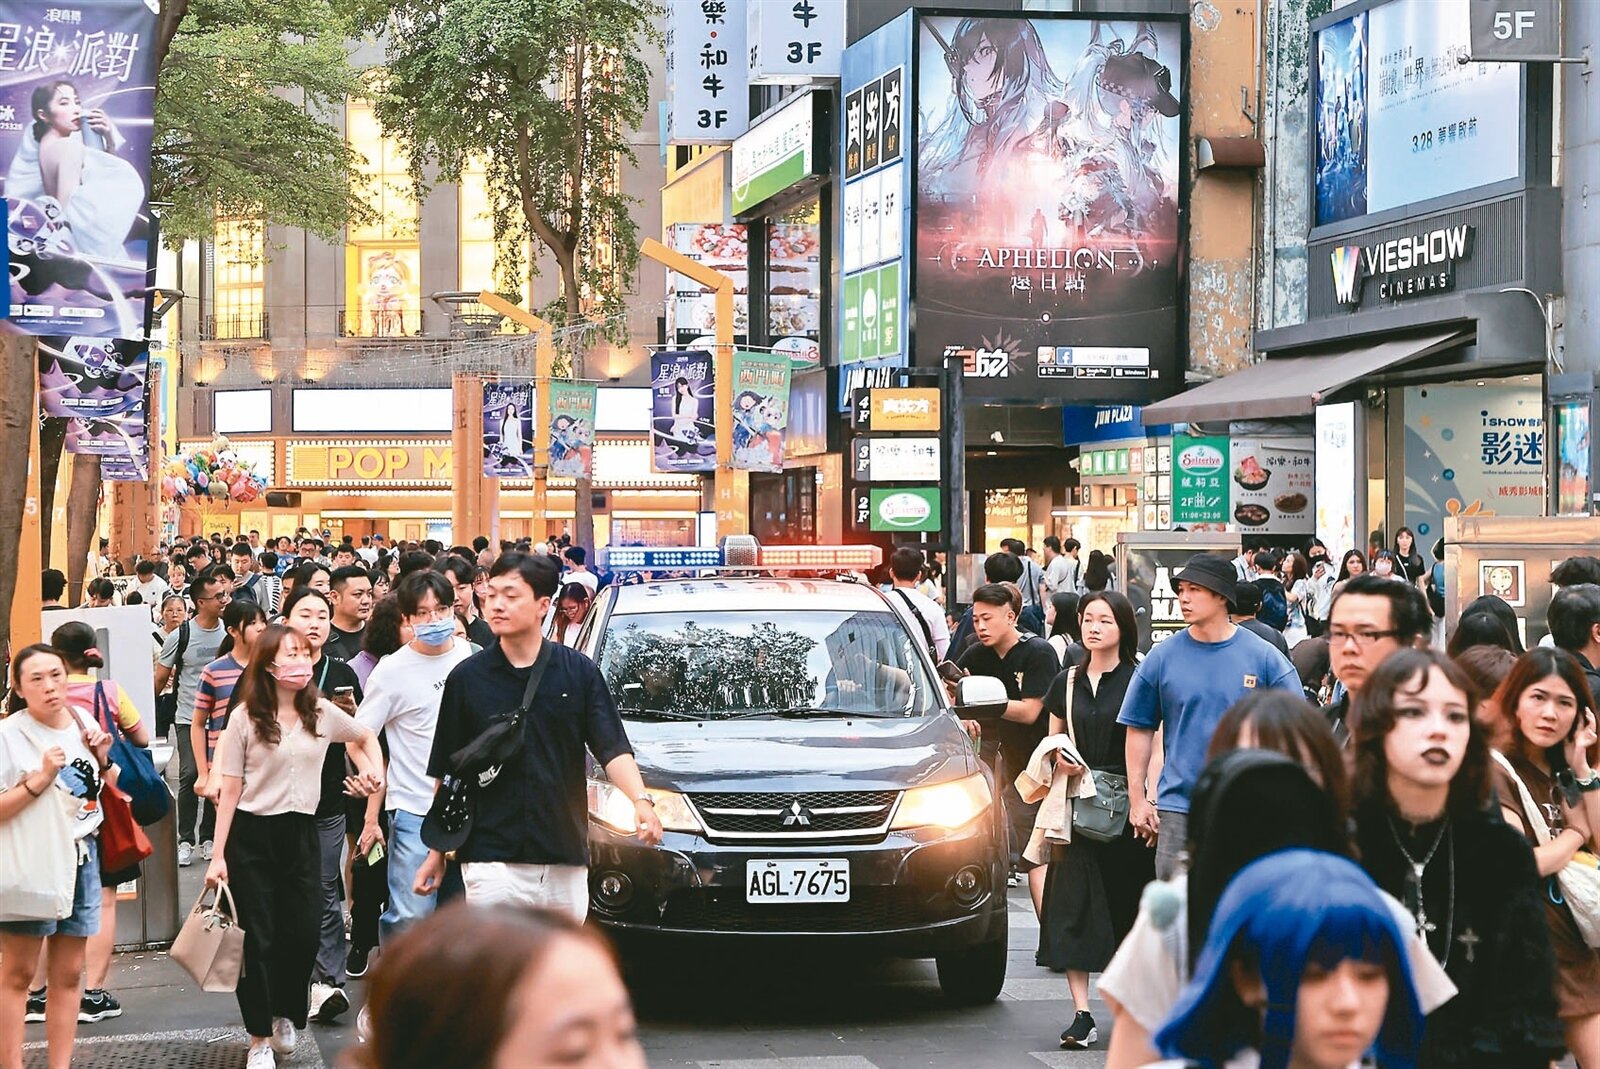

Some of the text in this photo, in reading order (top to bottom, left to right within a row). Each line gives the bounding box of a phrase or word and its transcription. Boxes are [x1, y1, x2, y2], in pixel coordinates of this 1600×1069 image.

[1493, 11, 1536, 40] 5F
[786, 41, 823, 64] 3F
[697, 109, 728, 129] 3F
[1412, 130, 1433, 154] 3.28
[977, 247, 1116, 274] APHELION
[1365, 224, 1468, 276] VIESHOW
[1380, 272, 1447, 299] CINEMAS
[658, 362, 708, 381] 星浪派對
[1111, 405, 1133, 423] PLAZA
[330, 448, 408, 479] POP
[1181, 497, 1193, 507] 2F
[720, 511, 733, 521] 24
[478, 764, 498, 783] NIKE
